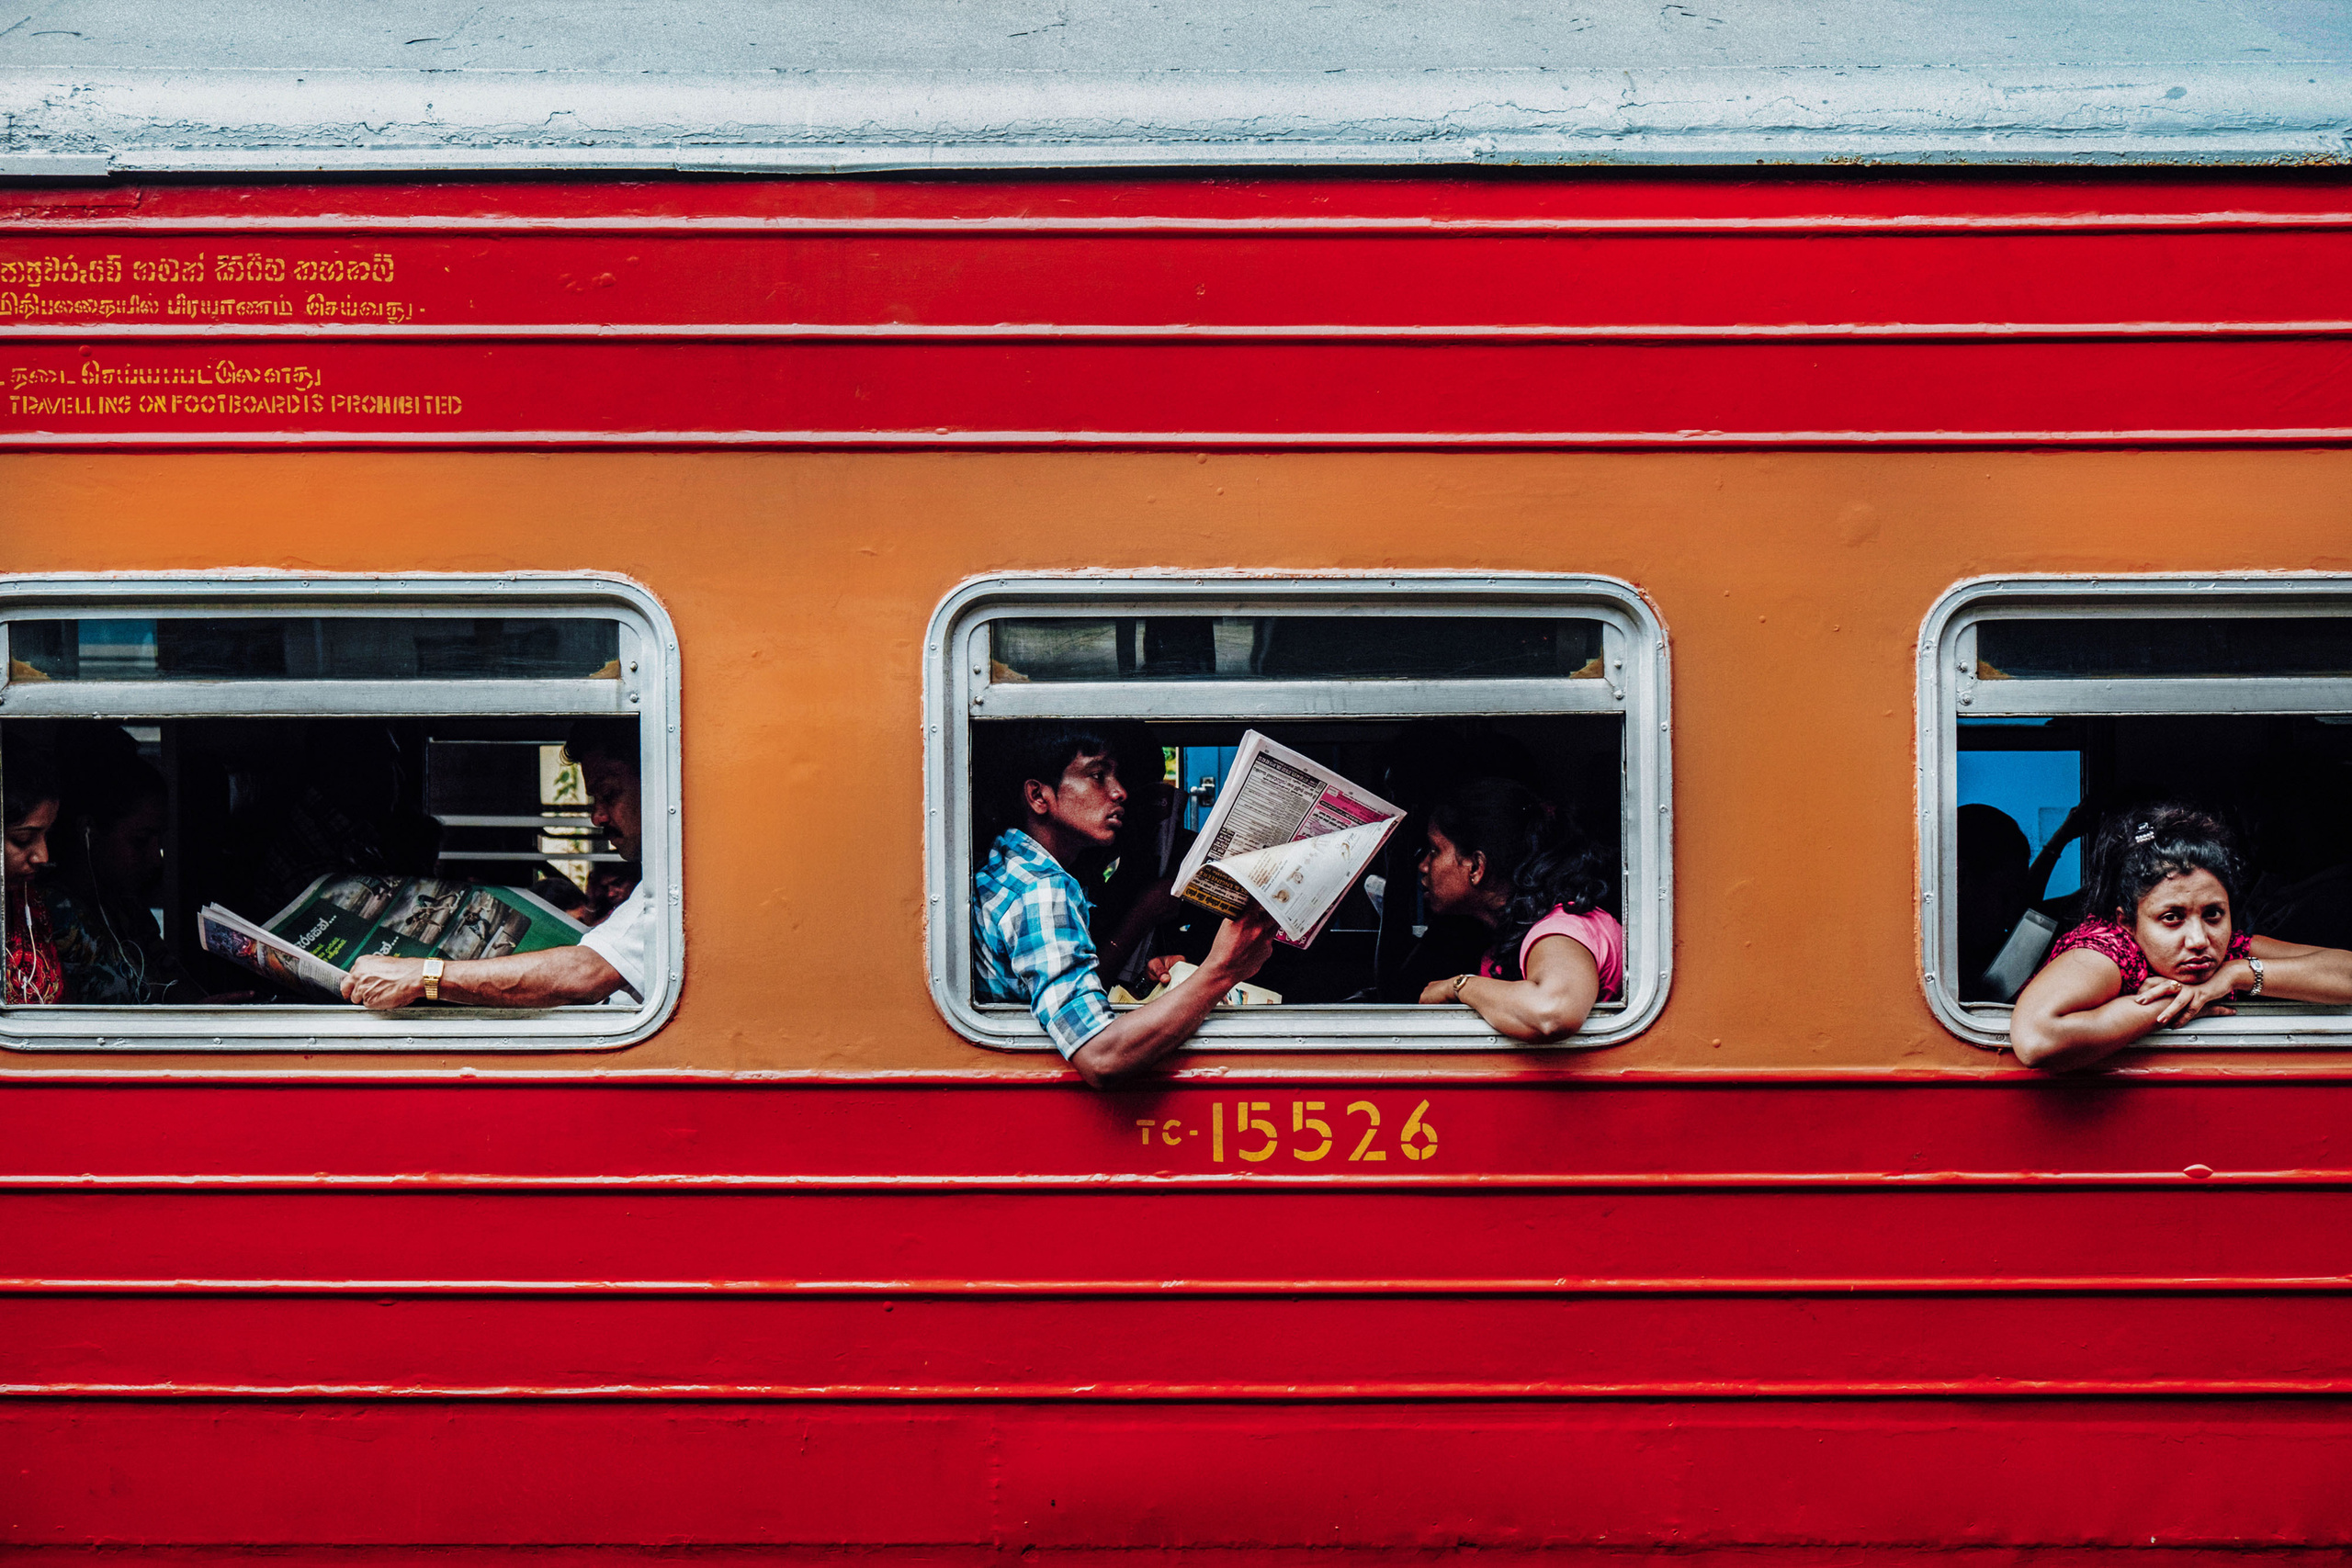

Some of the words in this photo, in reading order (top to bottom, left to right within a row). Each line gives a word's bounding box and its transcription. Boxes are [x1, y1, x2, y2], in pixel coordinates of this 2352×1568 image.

[9, 395, 131, 414] TRAVELLING
[139, 395, 167, 413] ON
[171, 394, 300, 413] FOOTBOARD
[303, 393, 324, 413] IS
[331, 394, 462, 414] PROHIBITED
